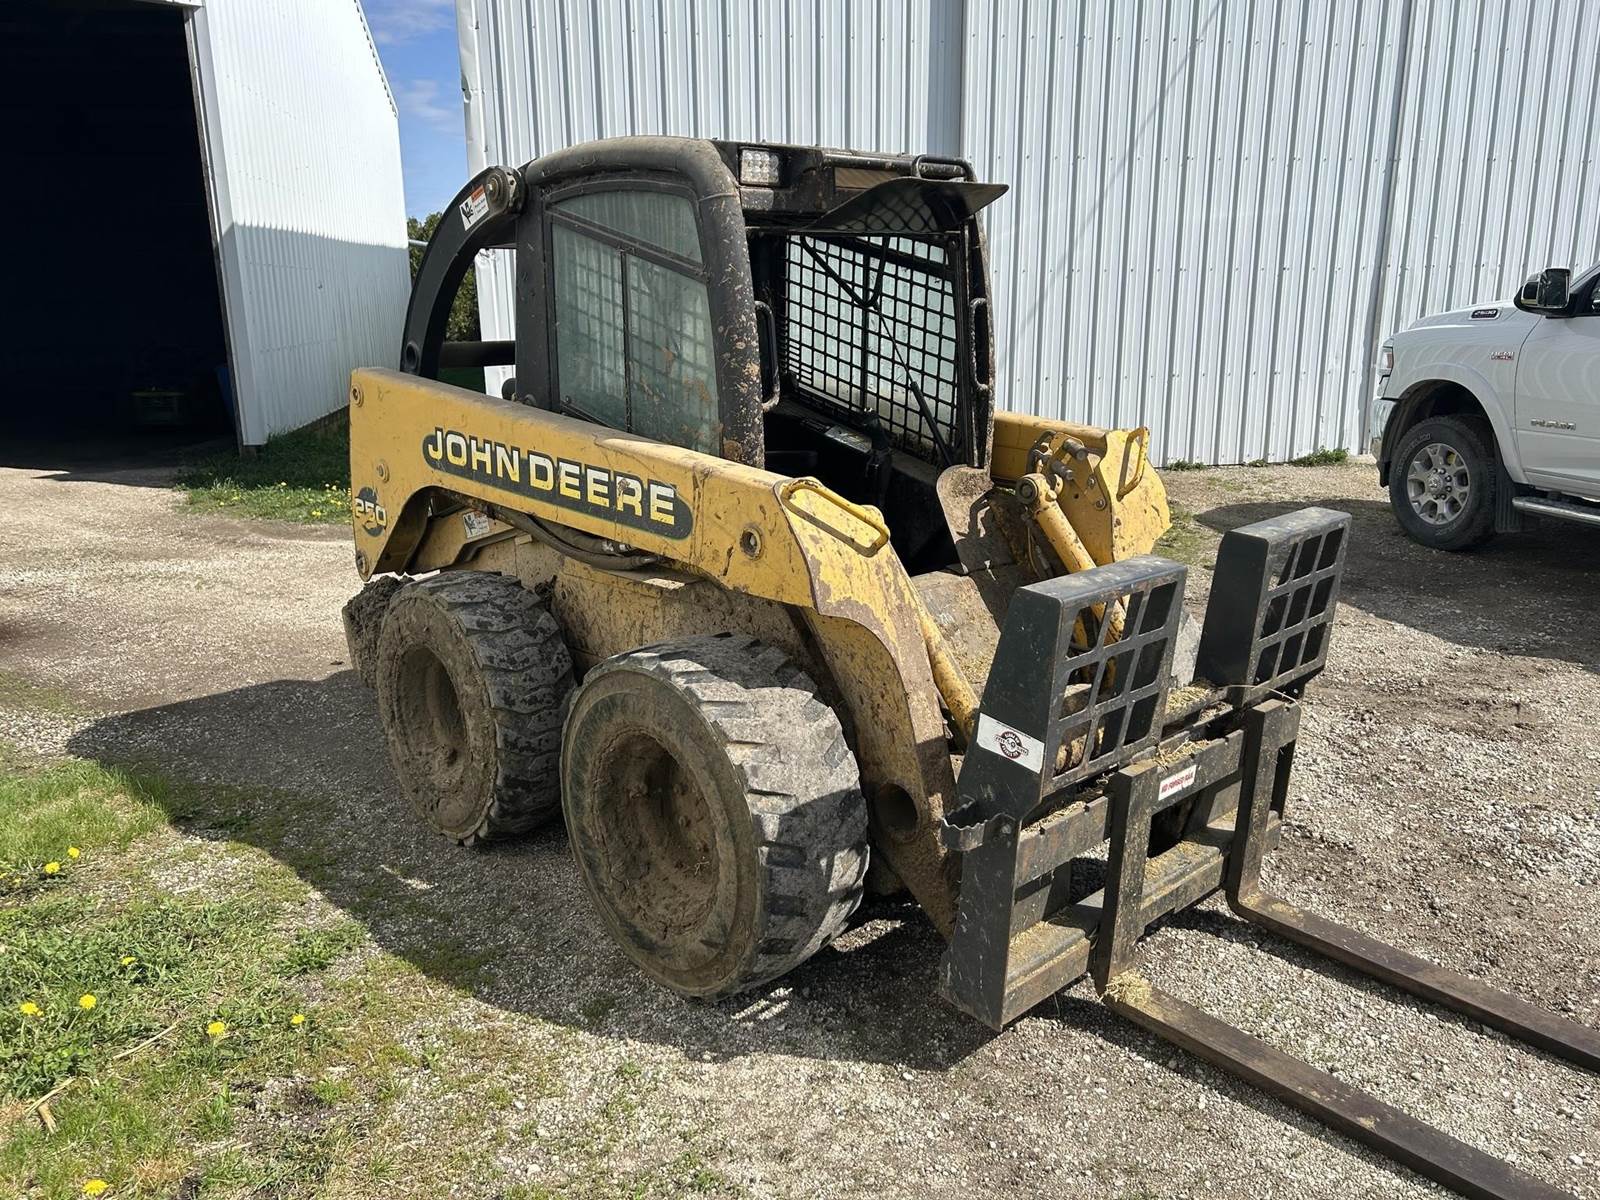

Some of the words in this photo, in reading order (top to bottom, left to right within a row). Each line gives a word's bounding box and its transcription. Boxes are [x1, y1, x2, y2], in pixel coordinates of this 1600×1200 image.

[427, 430, 520, 483] JOHN
[529, 452, 676, 526] DEERE
[355, 498, 387, 526] 250
